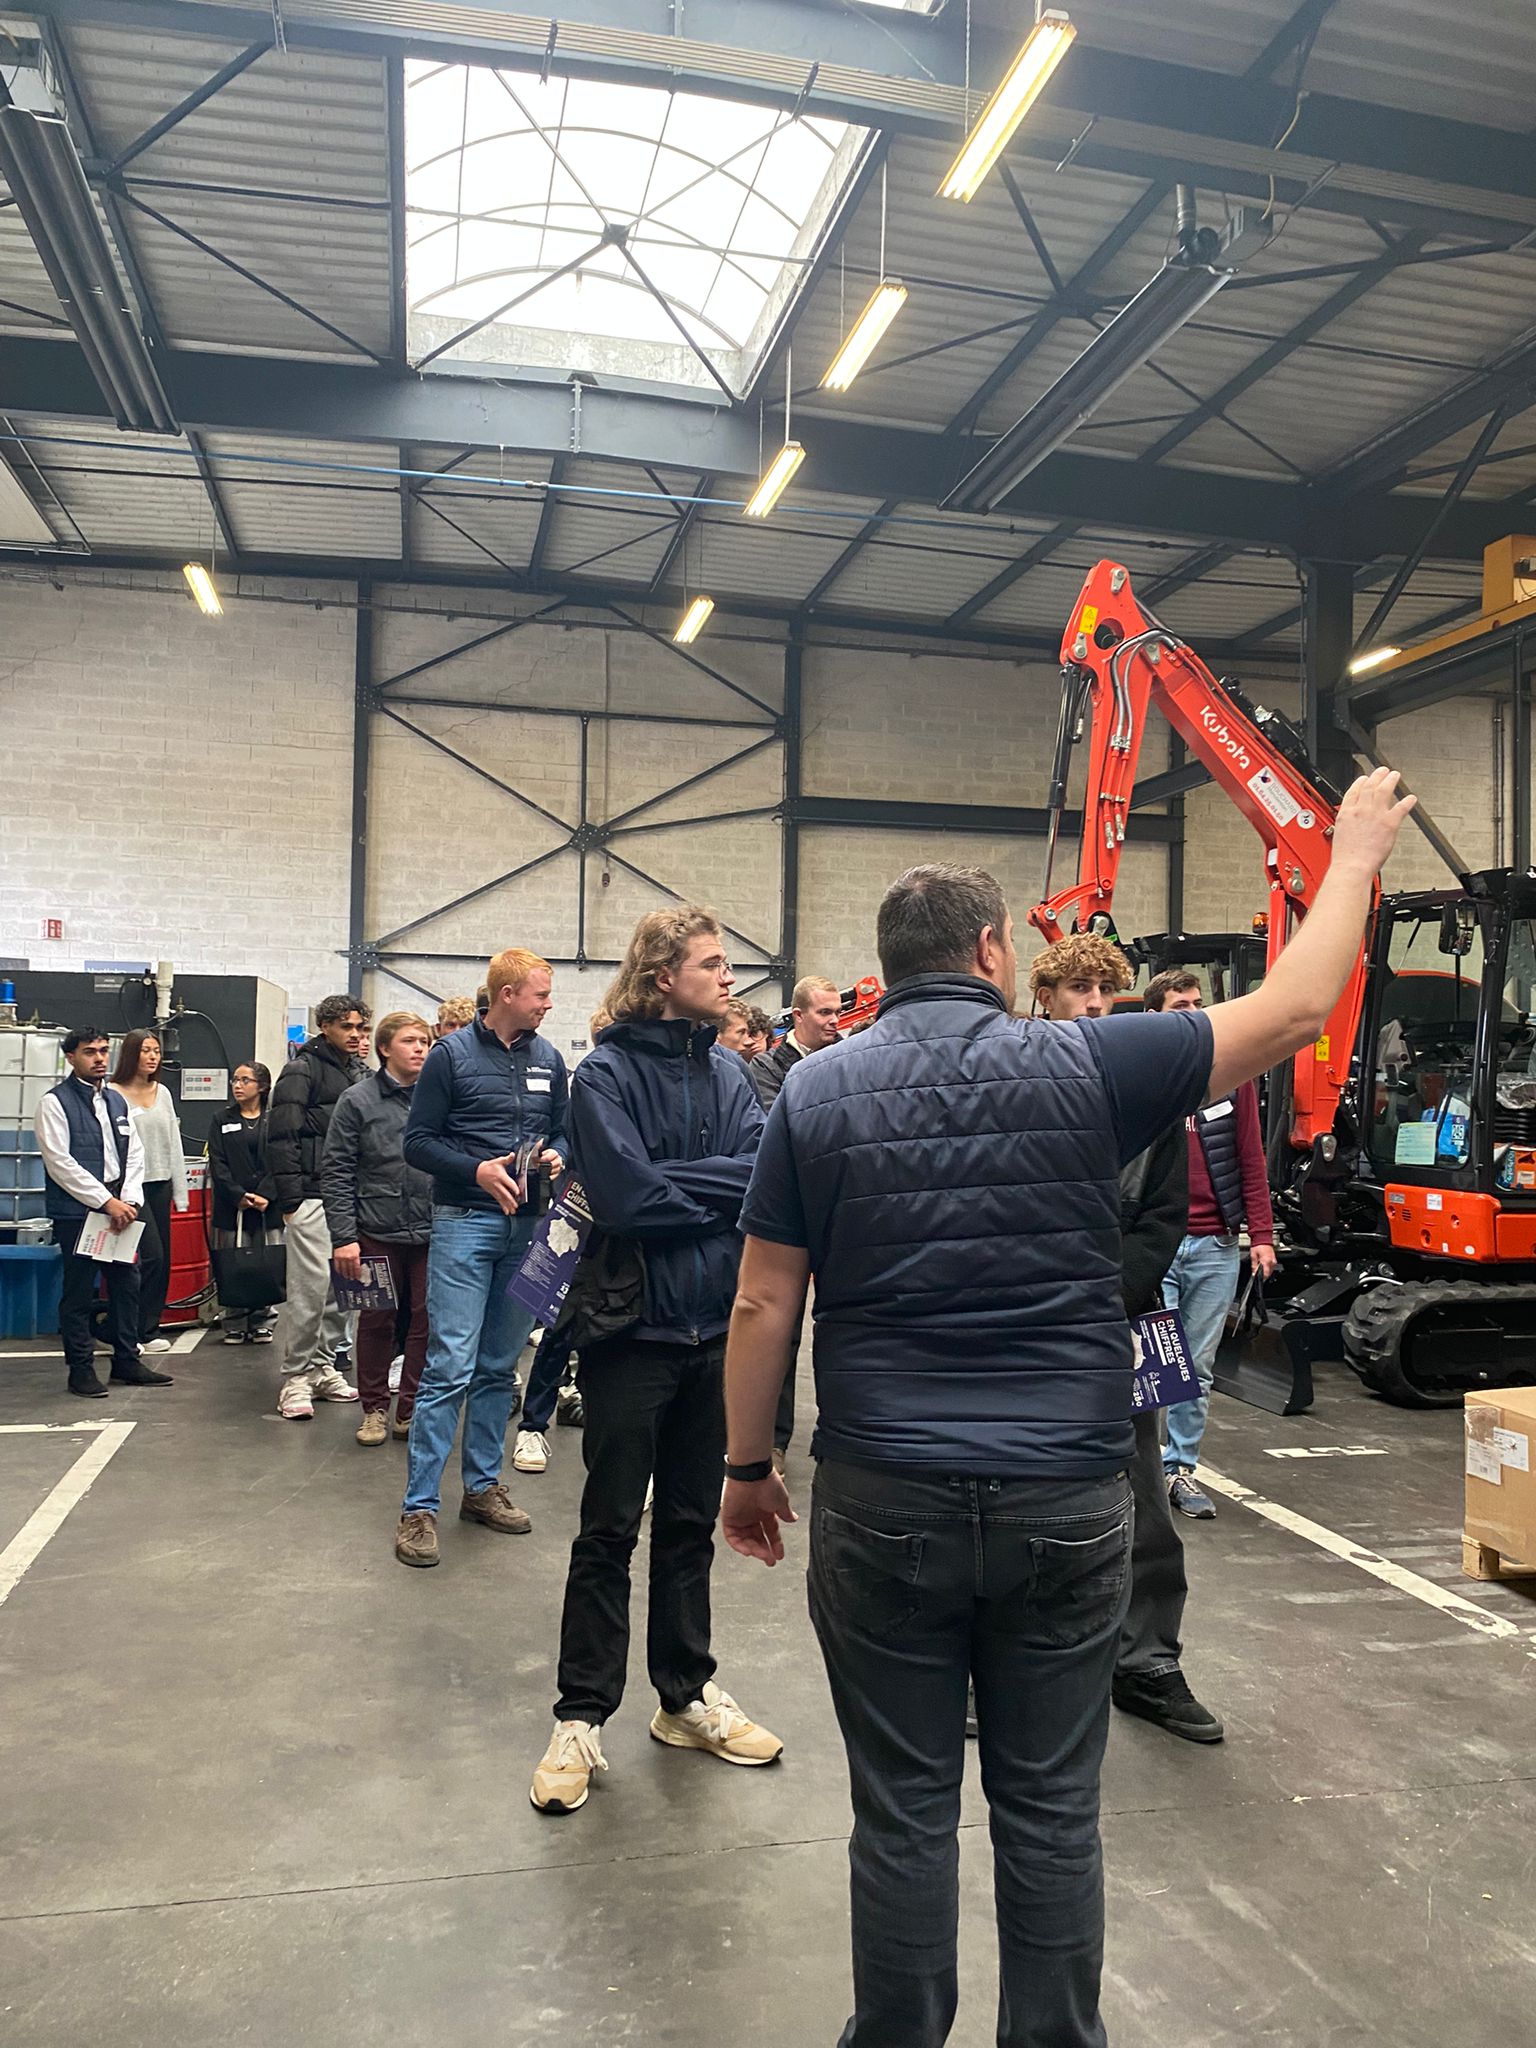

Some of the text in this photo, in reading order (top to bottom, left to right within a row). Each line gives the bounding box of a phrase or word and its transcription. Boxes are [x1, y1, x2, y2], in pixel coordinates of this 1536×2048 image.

[1200, 705, 1250, 770] Kubota
[1157, 1320, 1176, 1364] CHIFFRES
[1166, 1318, 1190, 1382] EN QUELQUES
[1133, 1390, 1143, 1407] 280
